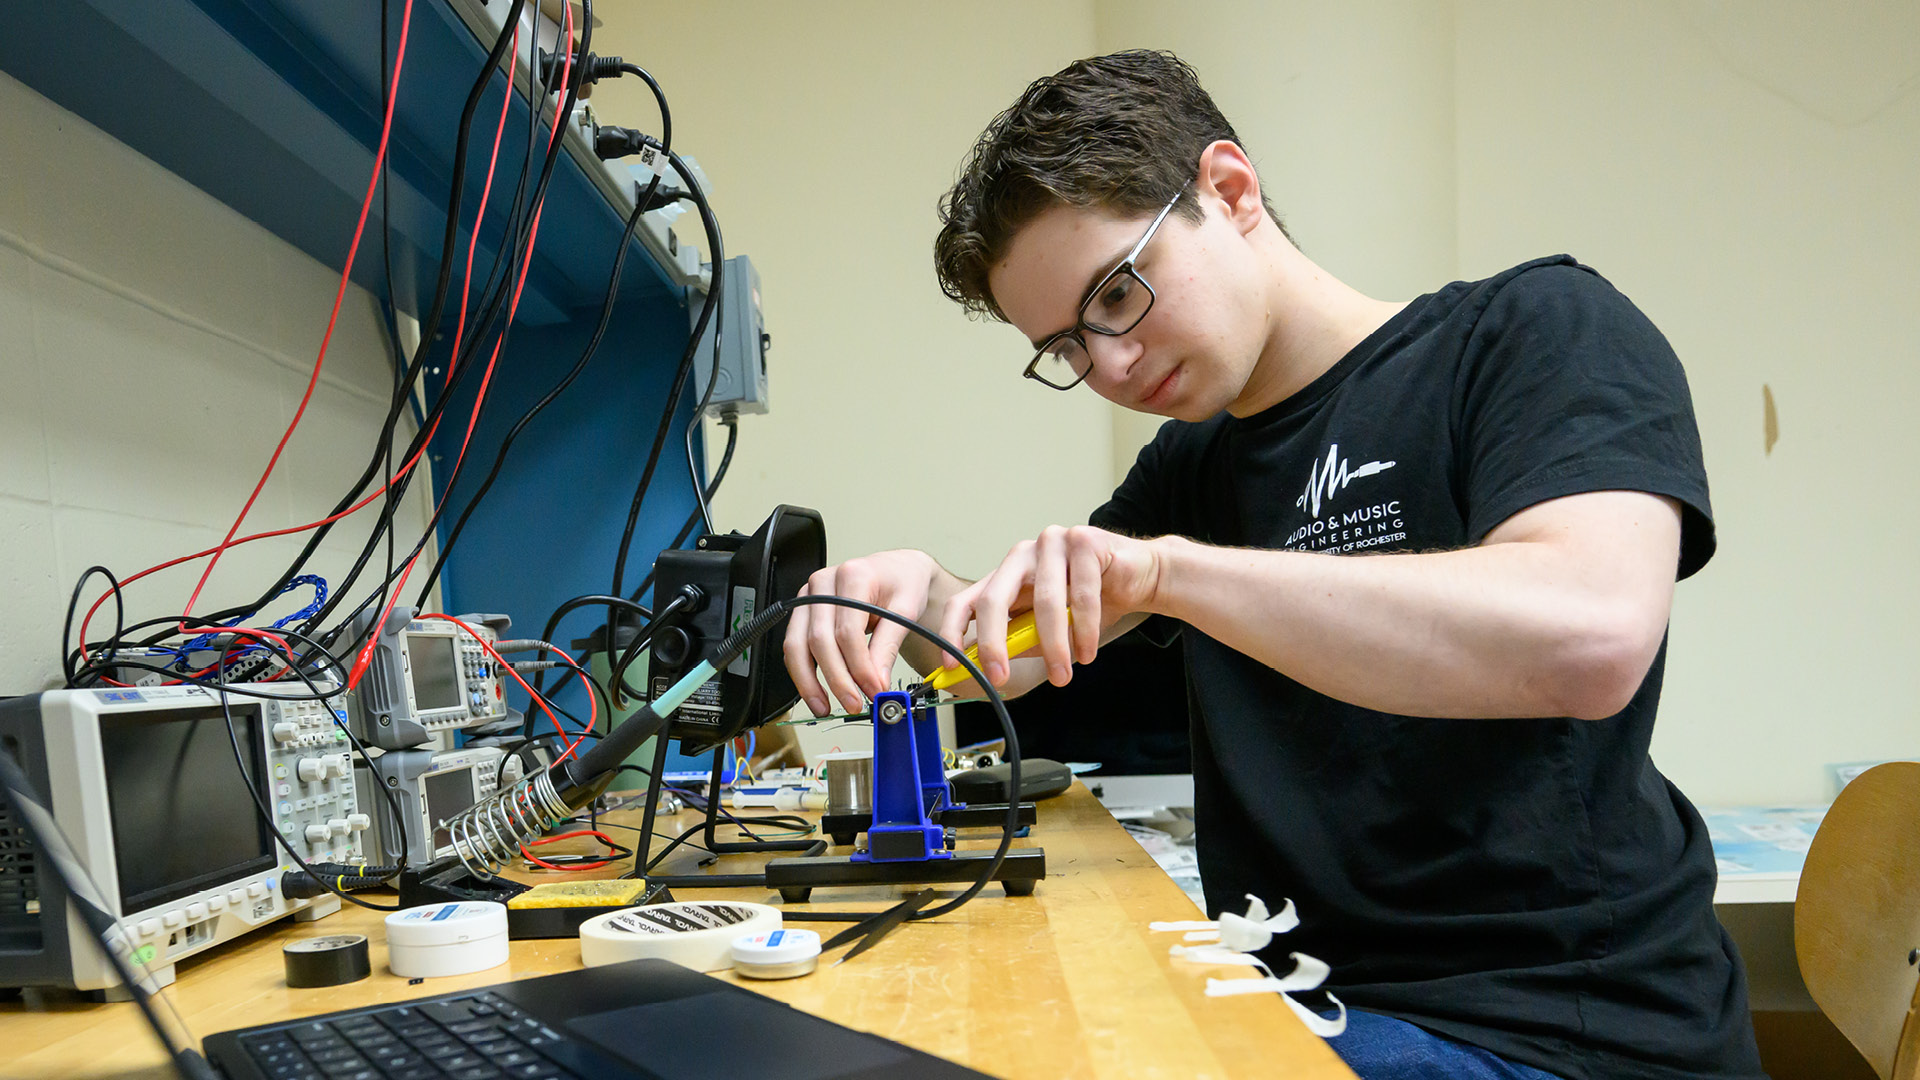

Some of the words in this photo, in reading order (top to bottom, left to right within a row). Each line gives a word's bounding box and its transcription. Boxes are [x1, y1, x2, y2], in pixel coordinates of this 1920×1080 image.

[1285, 521, 1325, 546] AUDIO
[1328, 516, 1339, 530] &
[1343, 501, 1401, 526] MUSIC
[1342, 542, 1355, 552] OF
[1356, 532, 1407, 549] ROCHESTER
